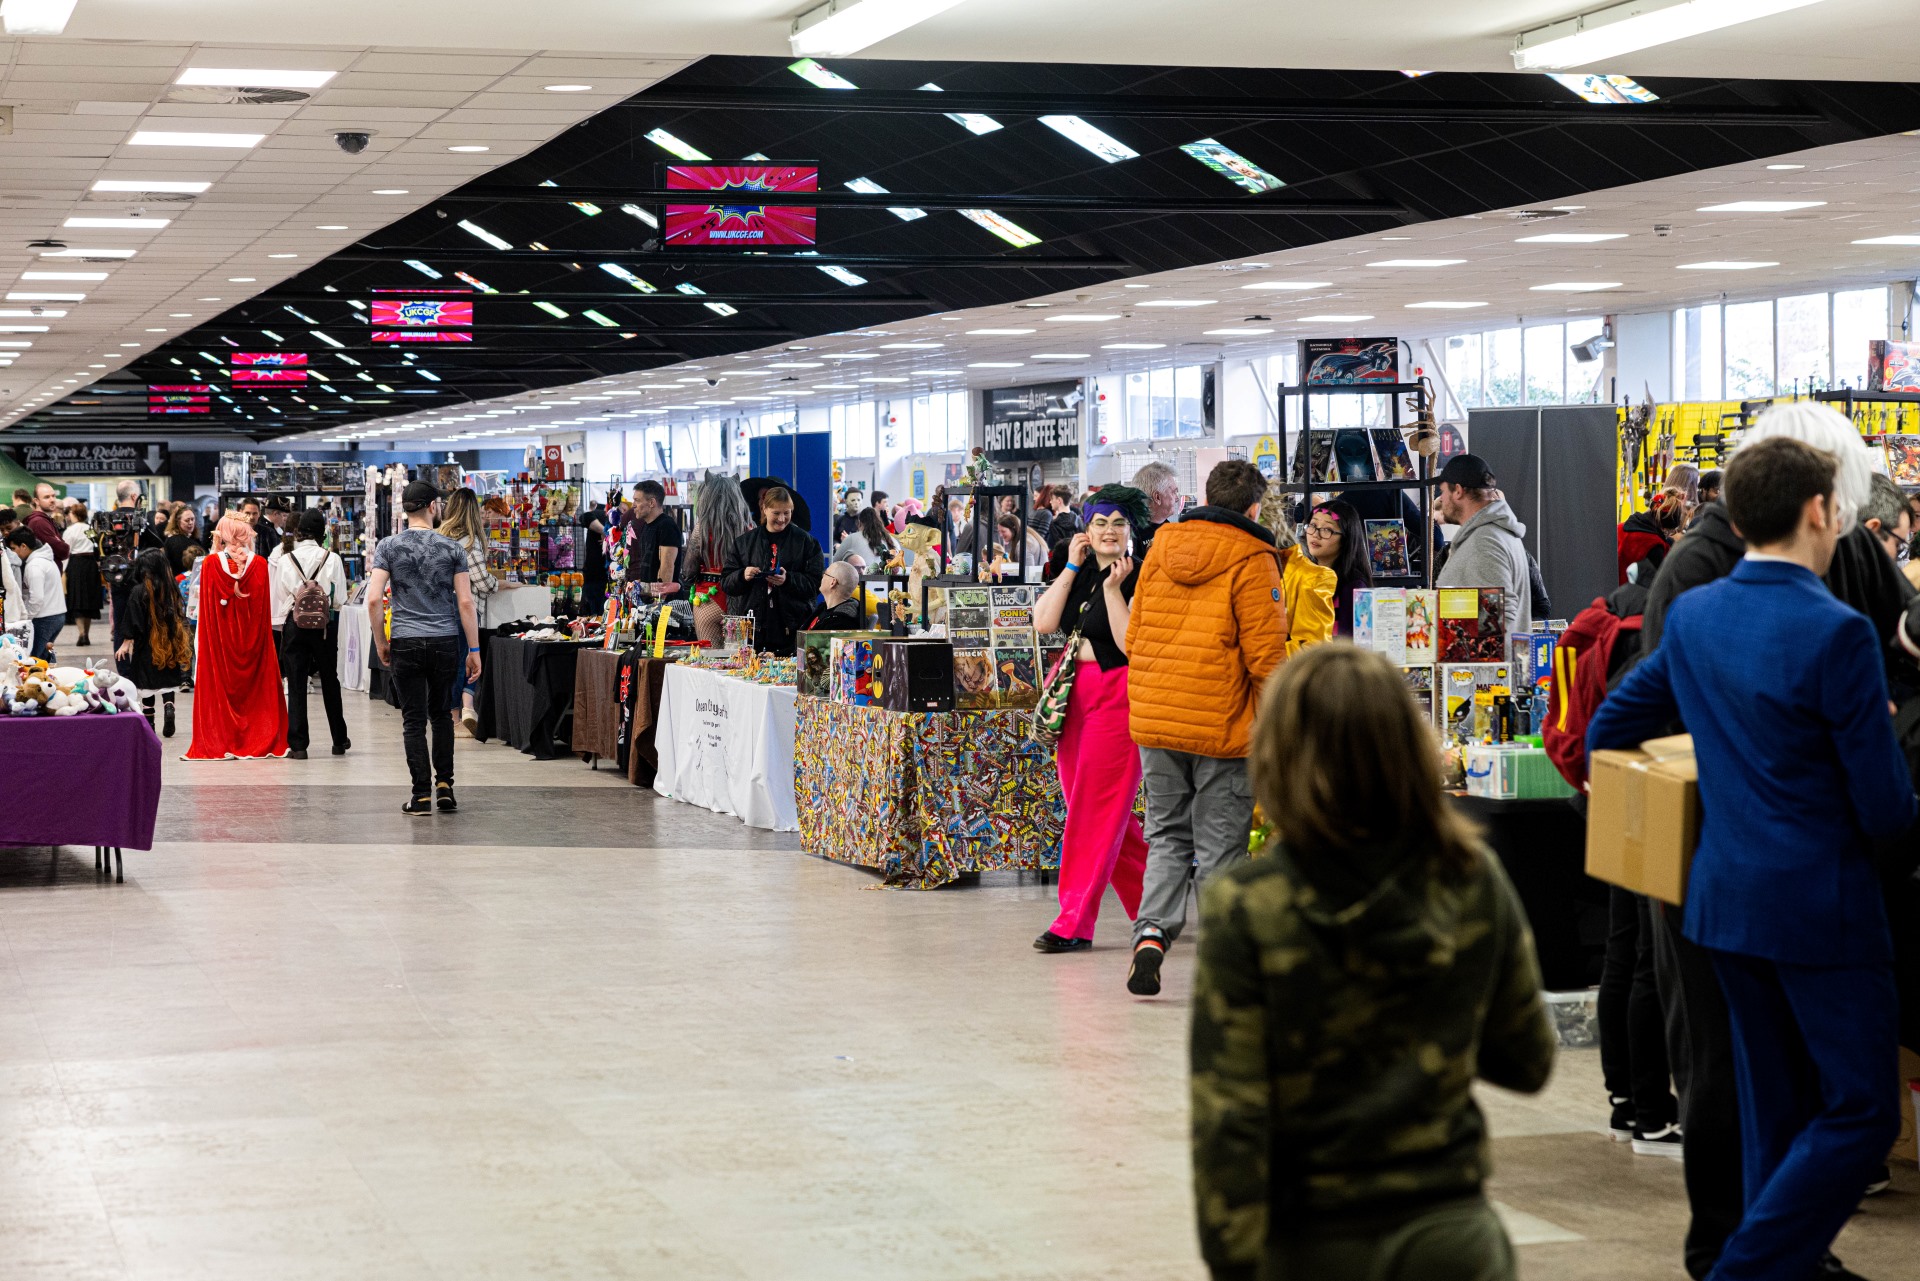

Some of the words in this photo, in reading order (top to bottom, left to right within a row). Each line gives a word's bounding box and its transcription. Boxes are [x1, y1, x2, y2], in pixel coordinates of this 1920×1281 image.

[709, 230, 764, 239] WWW.UKCGF.COM
[405, 308, 434, 316] UKCGF
[984, 422, 1012, 451] PASTY
[1013, 421, 1022, 449] &
[1023, 418, 1056, 449] COFFEE
[1057, 417, 1078, 446] SHO
[23, 445, 46, 461] The
[46, 446, 78, 463] Bear
[80, 446, 92, 460] &
[26, 461, 61, 470] PREMIUM
[64, 461, 99, 470] BURGERS
[102, 461, 109, 470] &
[111, 461, 136, 470] BEERS
[956, 592, 987, 605] DEAD
[999, 609, 1028, 617] SONIC
[956, 630, 988, 639] PREDATOR
